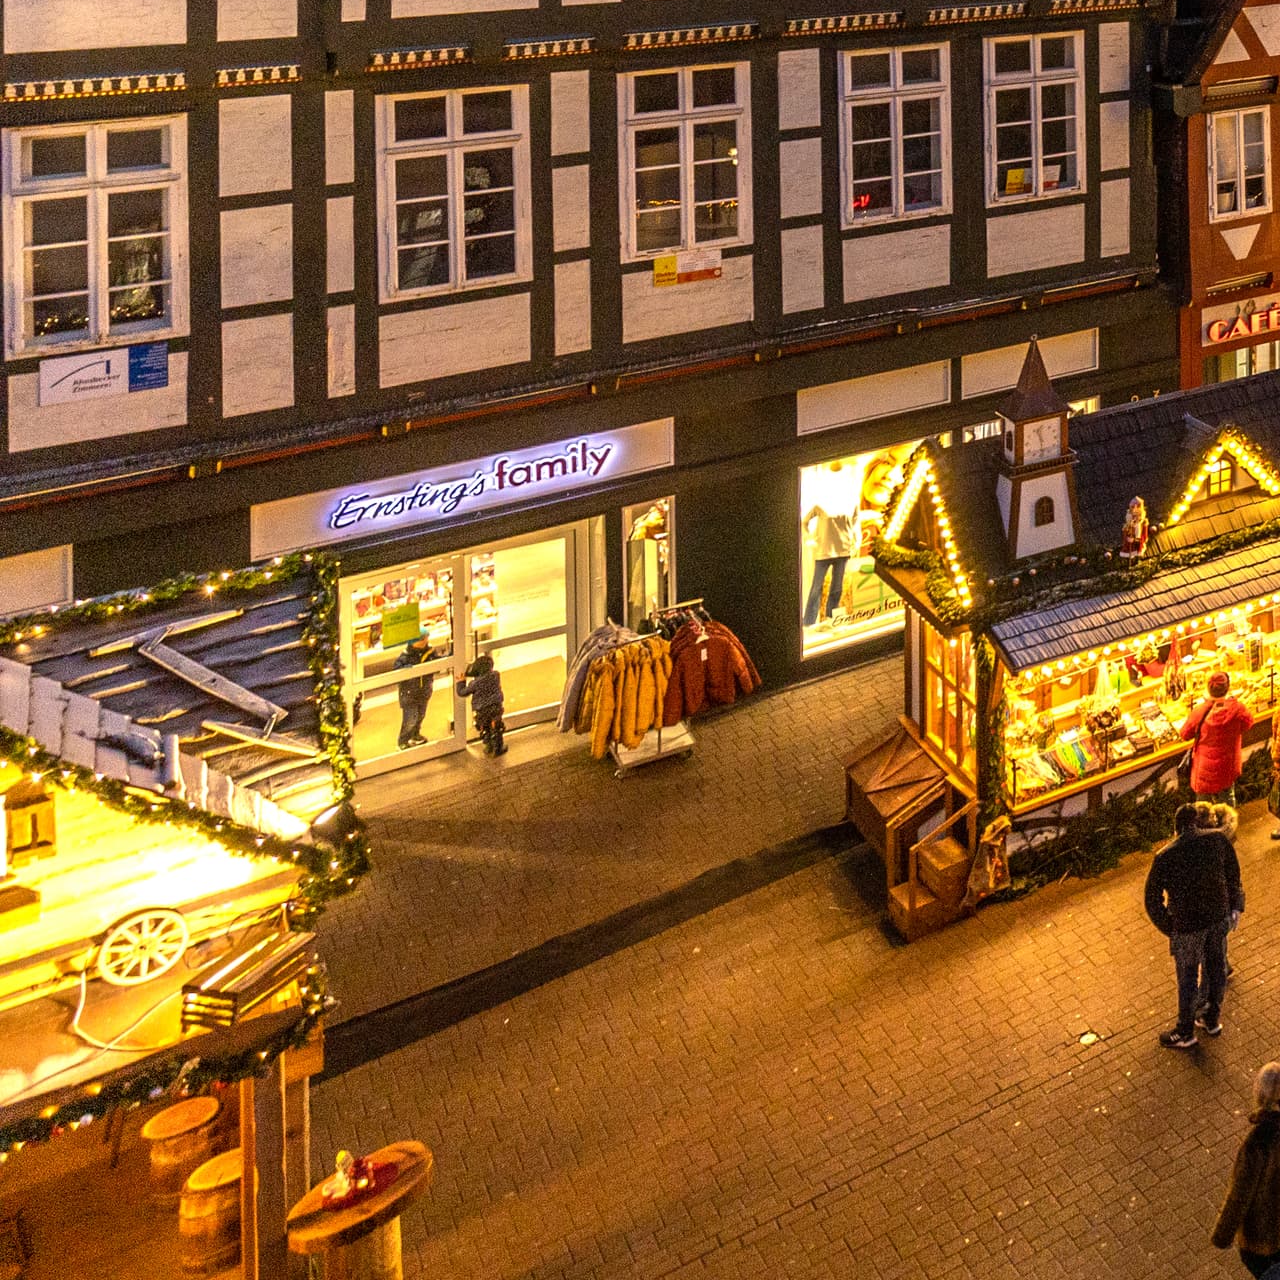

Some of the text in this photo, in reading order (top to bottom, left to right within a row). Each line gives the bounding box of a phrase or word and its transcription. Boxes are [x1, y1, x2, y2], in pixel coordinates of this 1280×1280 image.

[331, 441, 611, 529] Ernsting's family
[832, 606, 883, 627] Ernsting's
